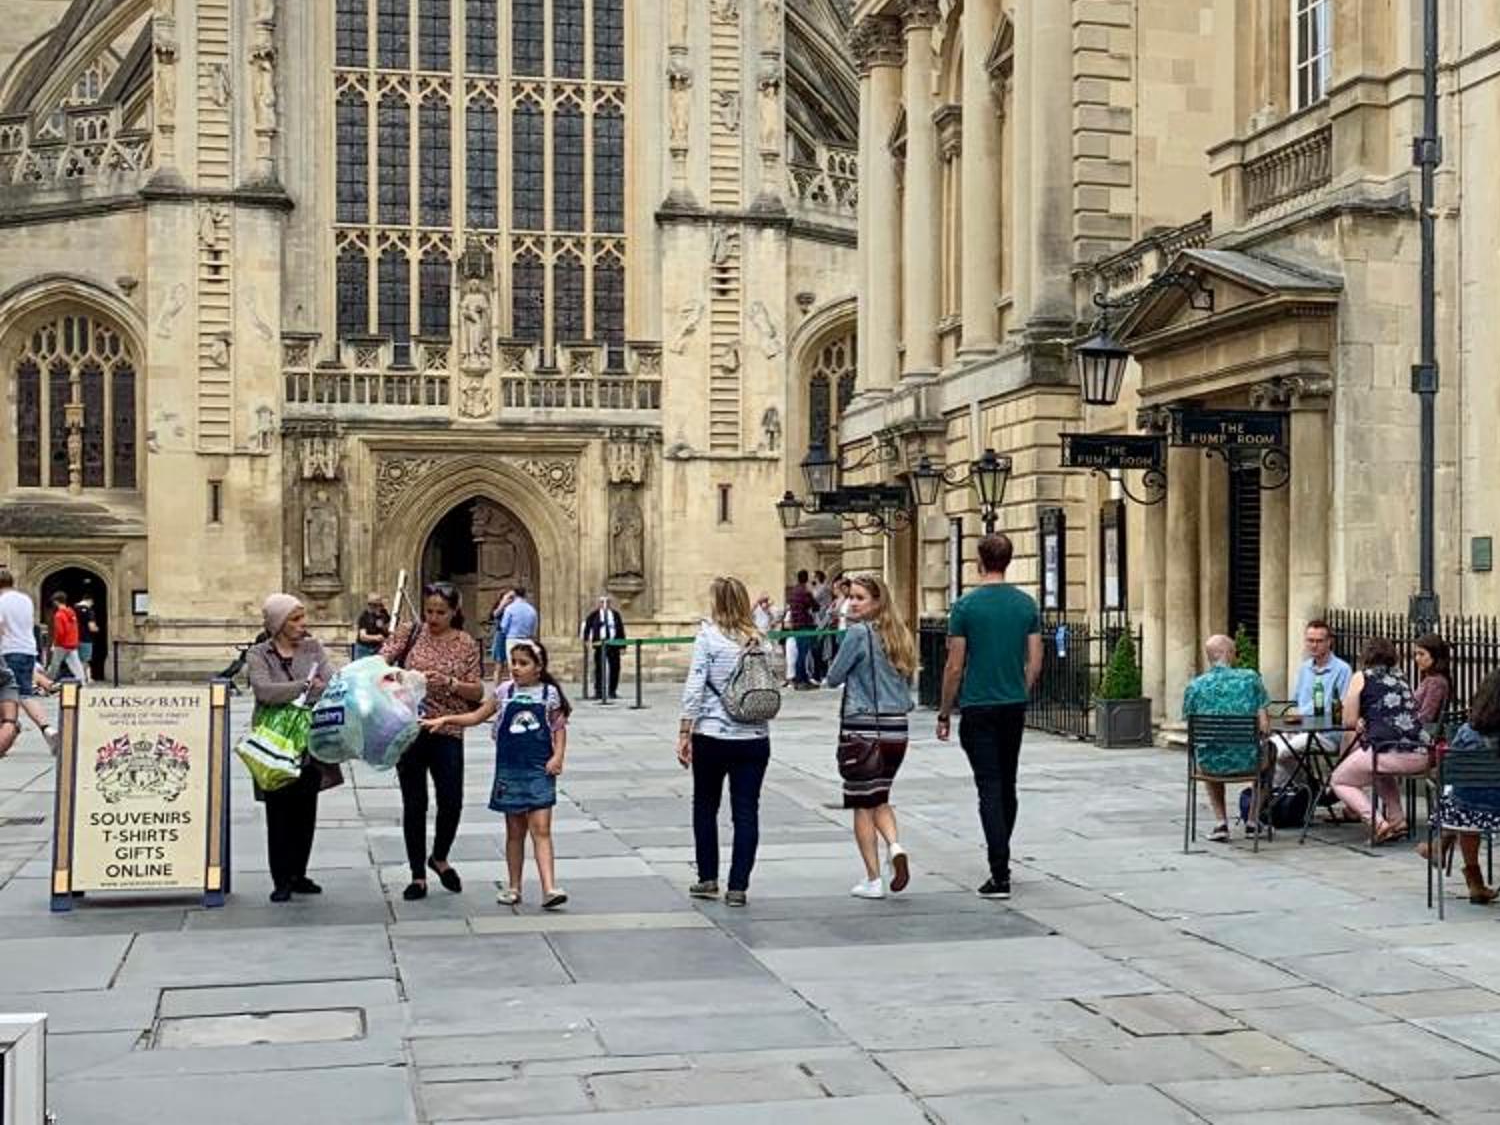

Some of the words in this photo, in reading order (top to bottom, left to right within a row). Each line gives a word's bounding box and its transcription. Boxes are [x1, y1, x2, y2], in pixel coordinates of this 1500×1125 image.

[1219, 422, 1245, 434] THE
[1190, 433, 1227, 444] PUMP
[1237, 433, 1276, 444] ROOM
[1104, 446, 1127, 455] THE
[1120, 455, 1153, 466] ROOM
[88, 696, 142, 707] JACKS
[159, 696, 201, 707] BATH
[90, 810, 192, 826] SOUVENIRS
[102, 829, 179, 843] T-SHIRTS
[115, 846, 165, 861] GIFTS
[105, 863, 173, 878] ONLINE
